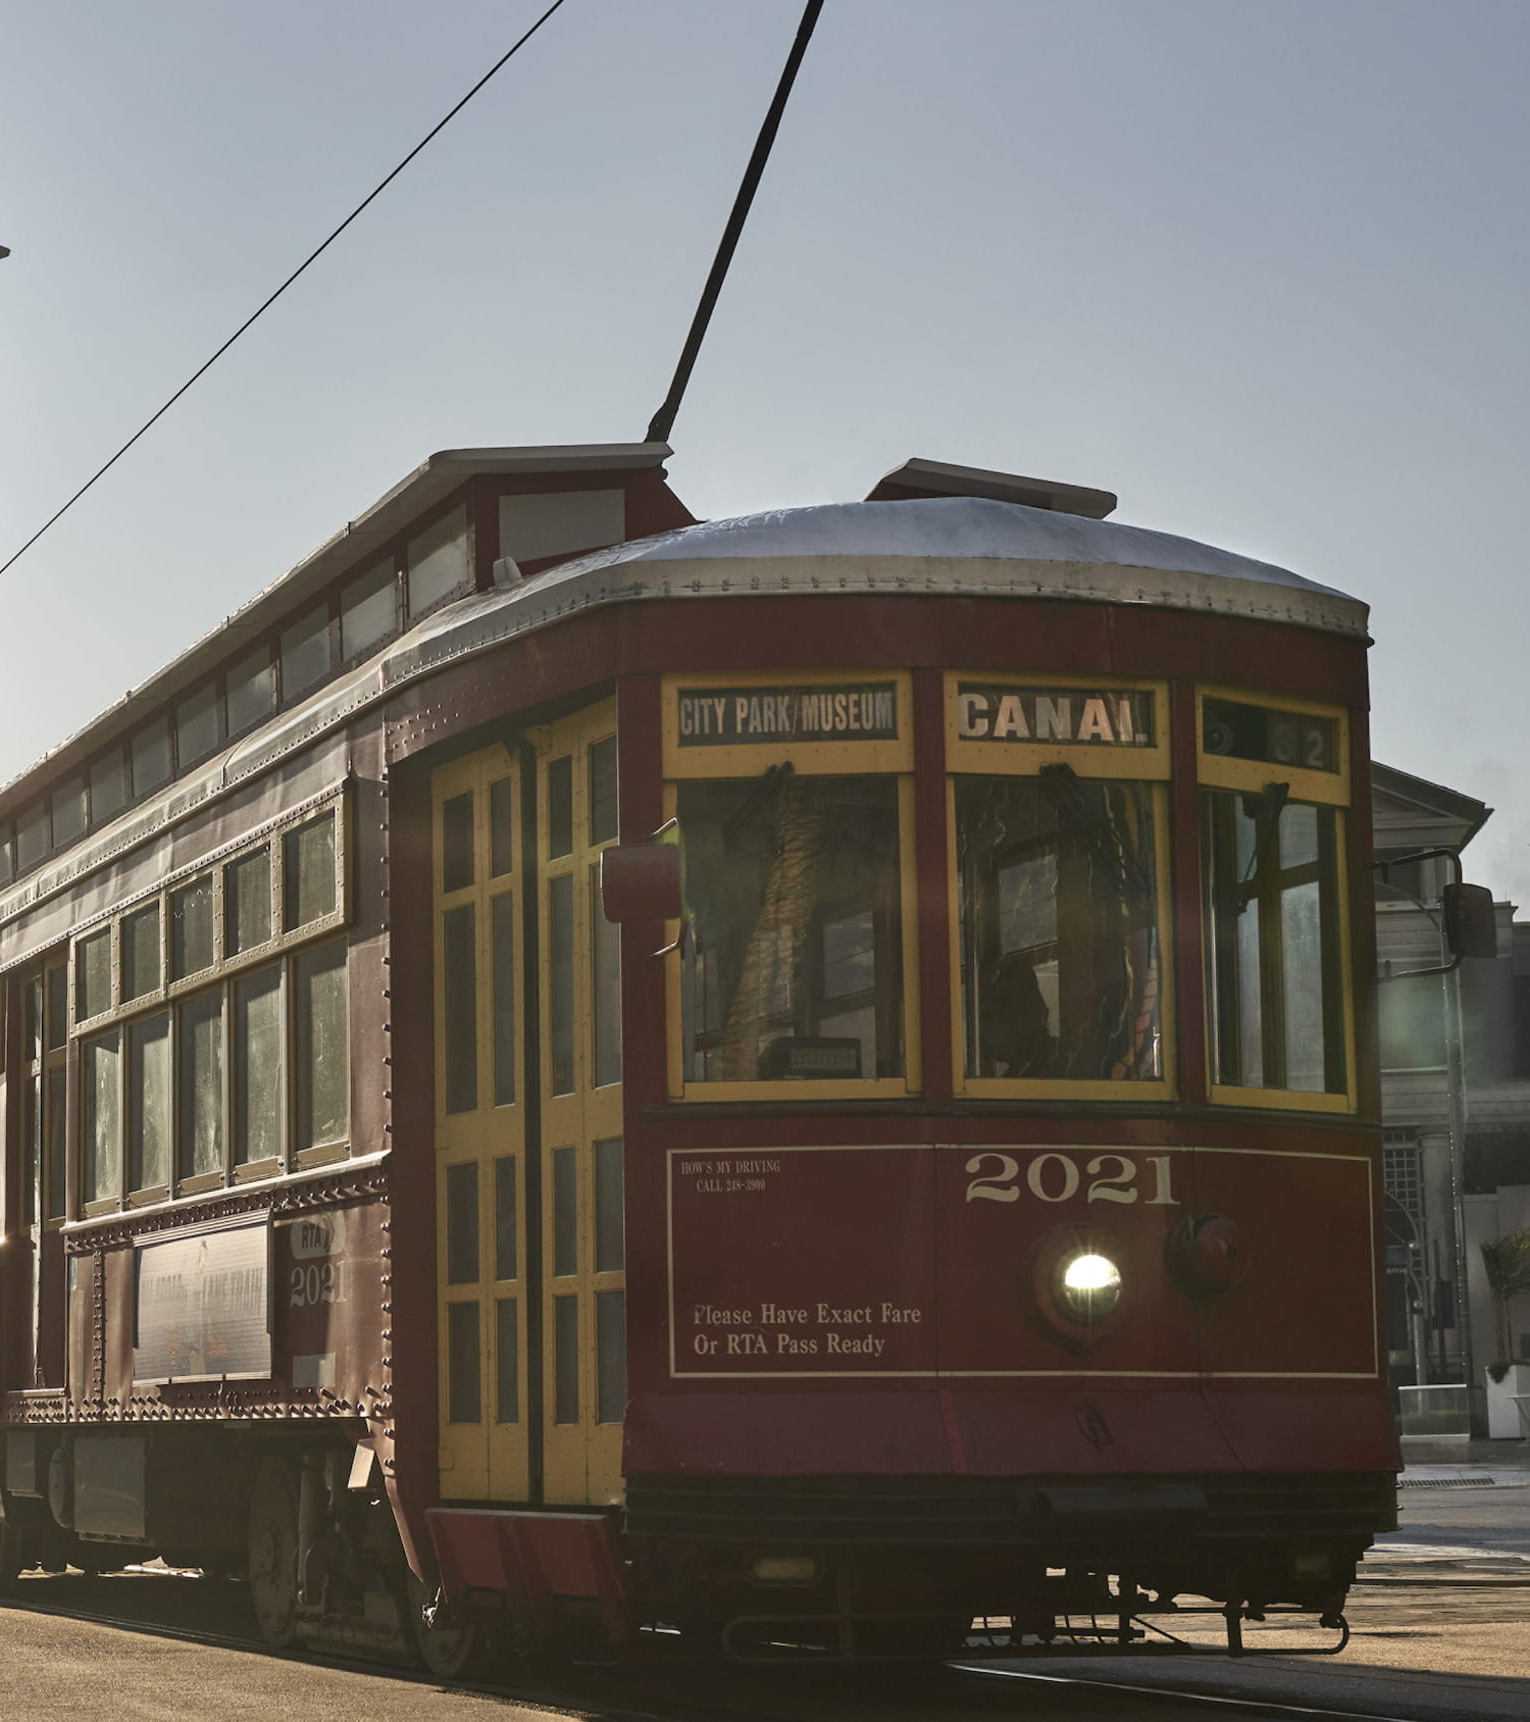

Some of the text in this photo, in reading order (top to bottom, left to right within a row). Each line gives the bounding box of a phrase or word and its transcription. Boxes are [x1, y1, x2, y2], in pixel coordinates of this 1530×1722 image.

[679, 697, 726, 736] CITY
[958, 692, 1149, 743] CANAL
[680, 1159, 781, 1175] HOW'S MY DRIVING
[965, 1152, 1182, 1205] 2021
[696, 1179, 723, 1192] CALL
[301, 1222, 323, 1250] RTA
[290, 1260, 348, 1308] 2021
[693, 1302, 921, 1325] Please Have Exact Fare
[693, 1332, 886, 1357] Or RTA Pass Ready
